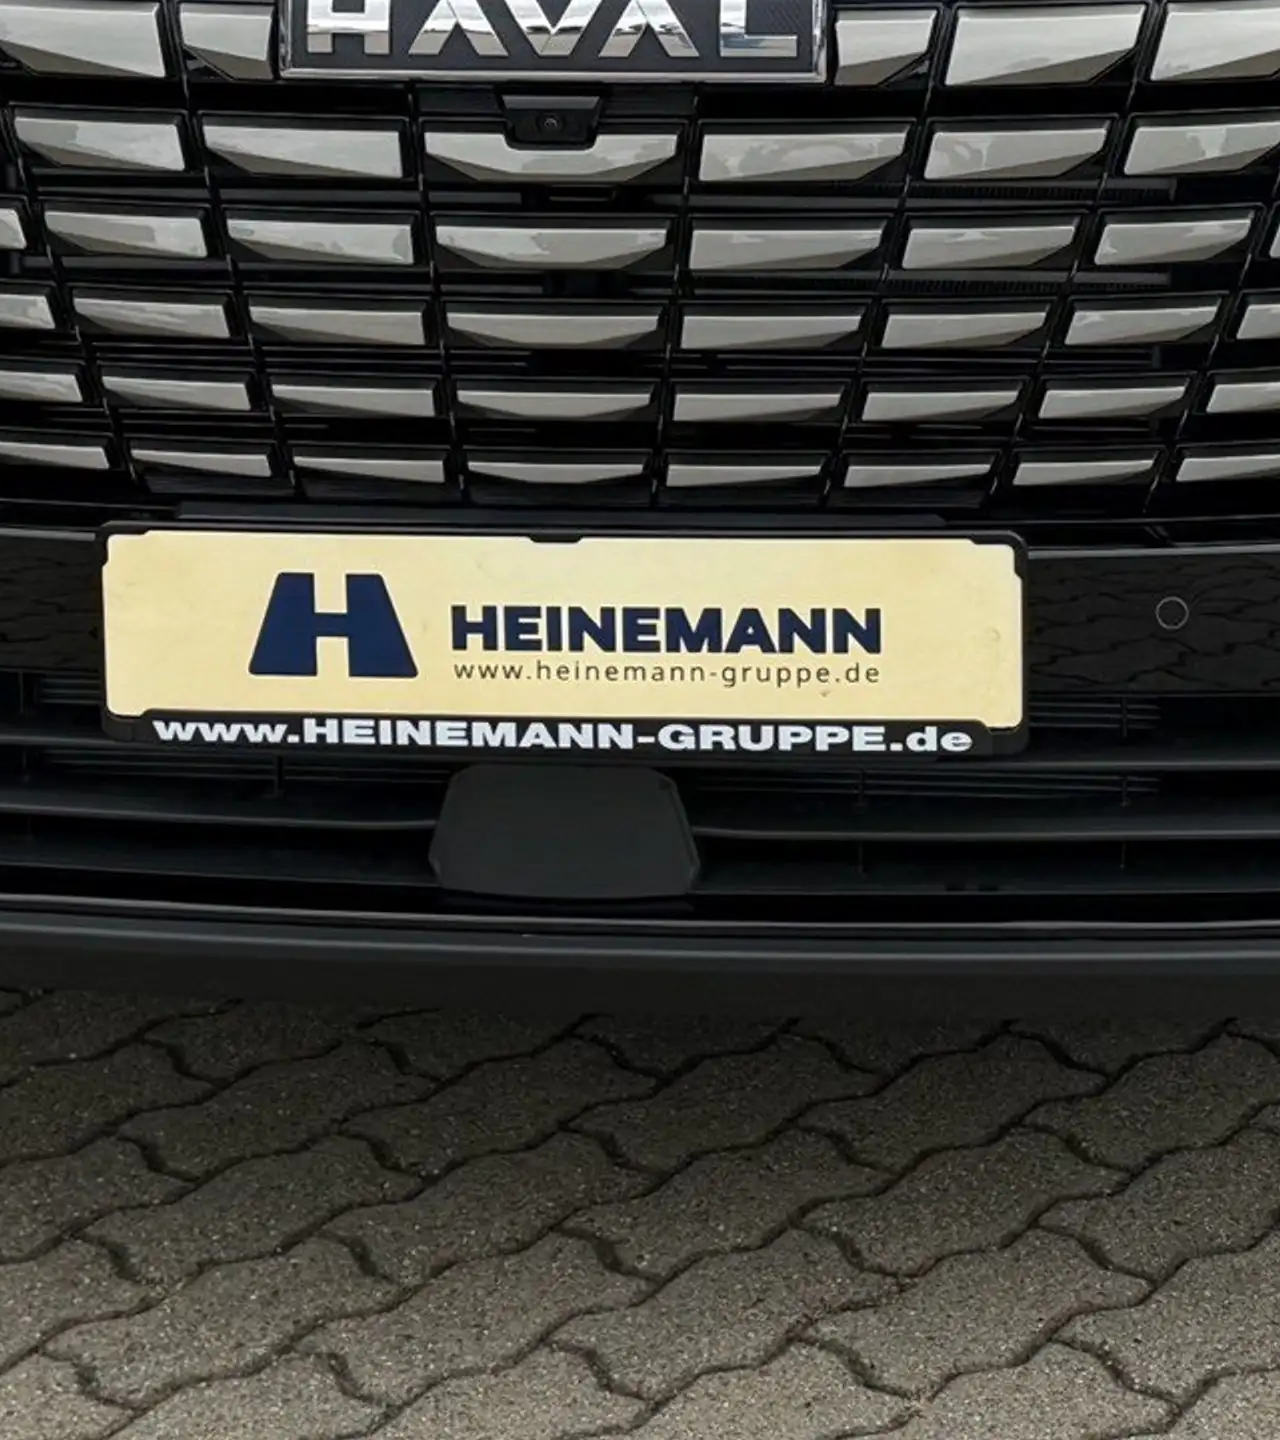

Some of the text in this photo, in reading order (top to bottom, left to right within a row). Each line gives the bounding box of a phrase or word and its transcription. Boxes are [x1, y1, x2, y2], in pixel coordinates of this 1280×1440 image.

[248, 572, 419, 678] H
[451, 605, 882, 654] HEINEMANN
[454, 659, 881, 688] www.heinemann-gruppe.de
[151, 717, 973, 752] www.HEINEMANN-GRUPPE.de
